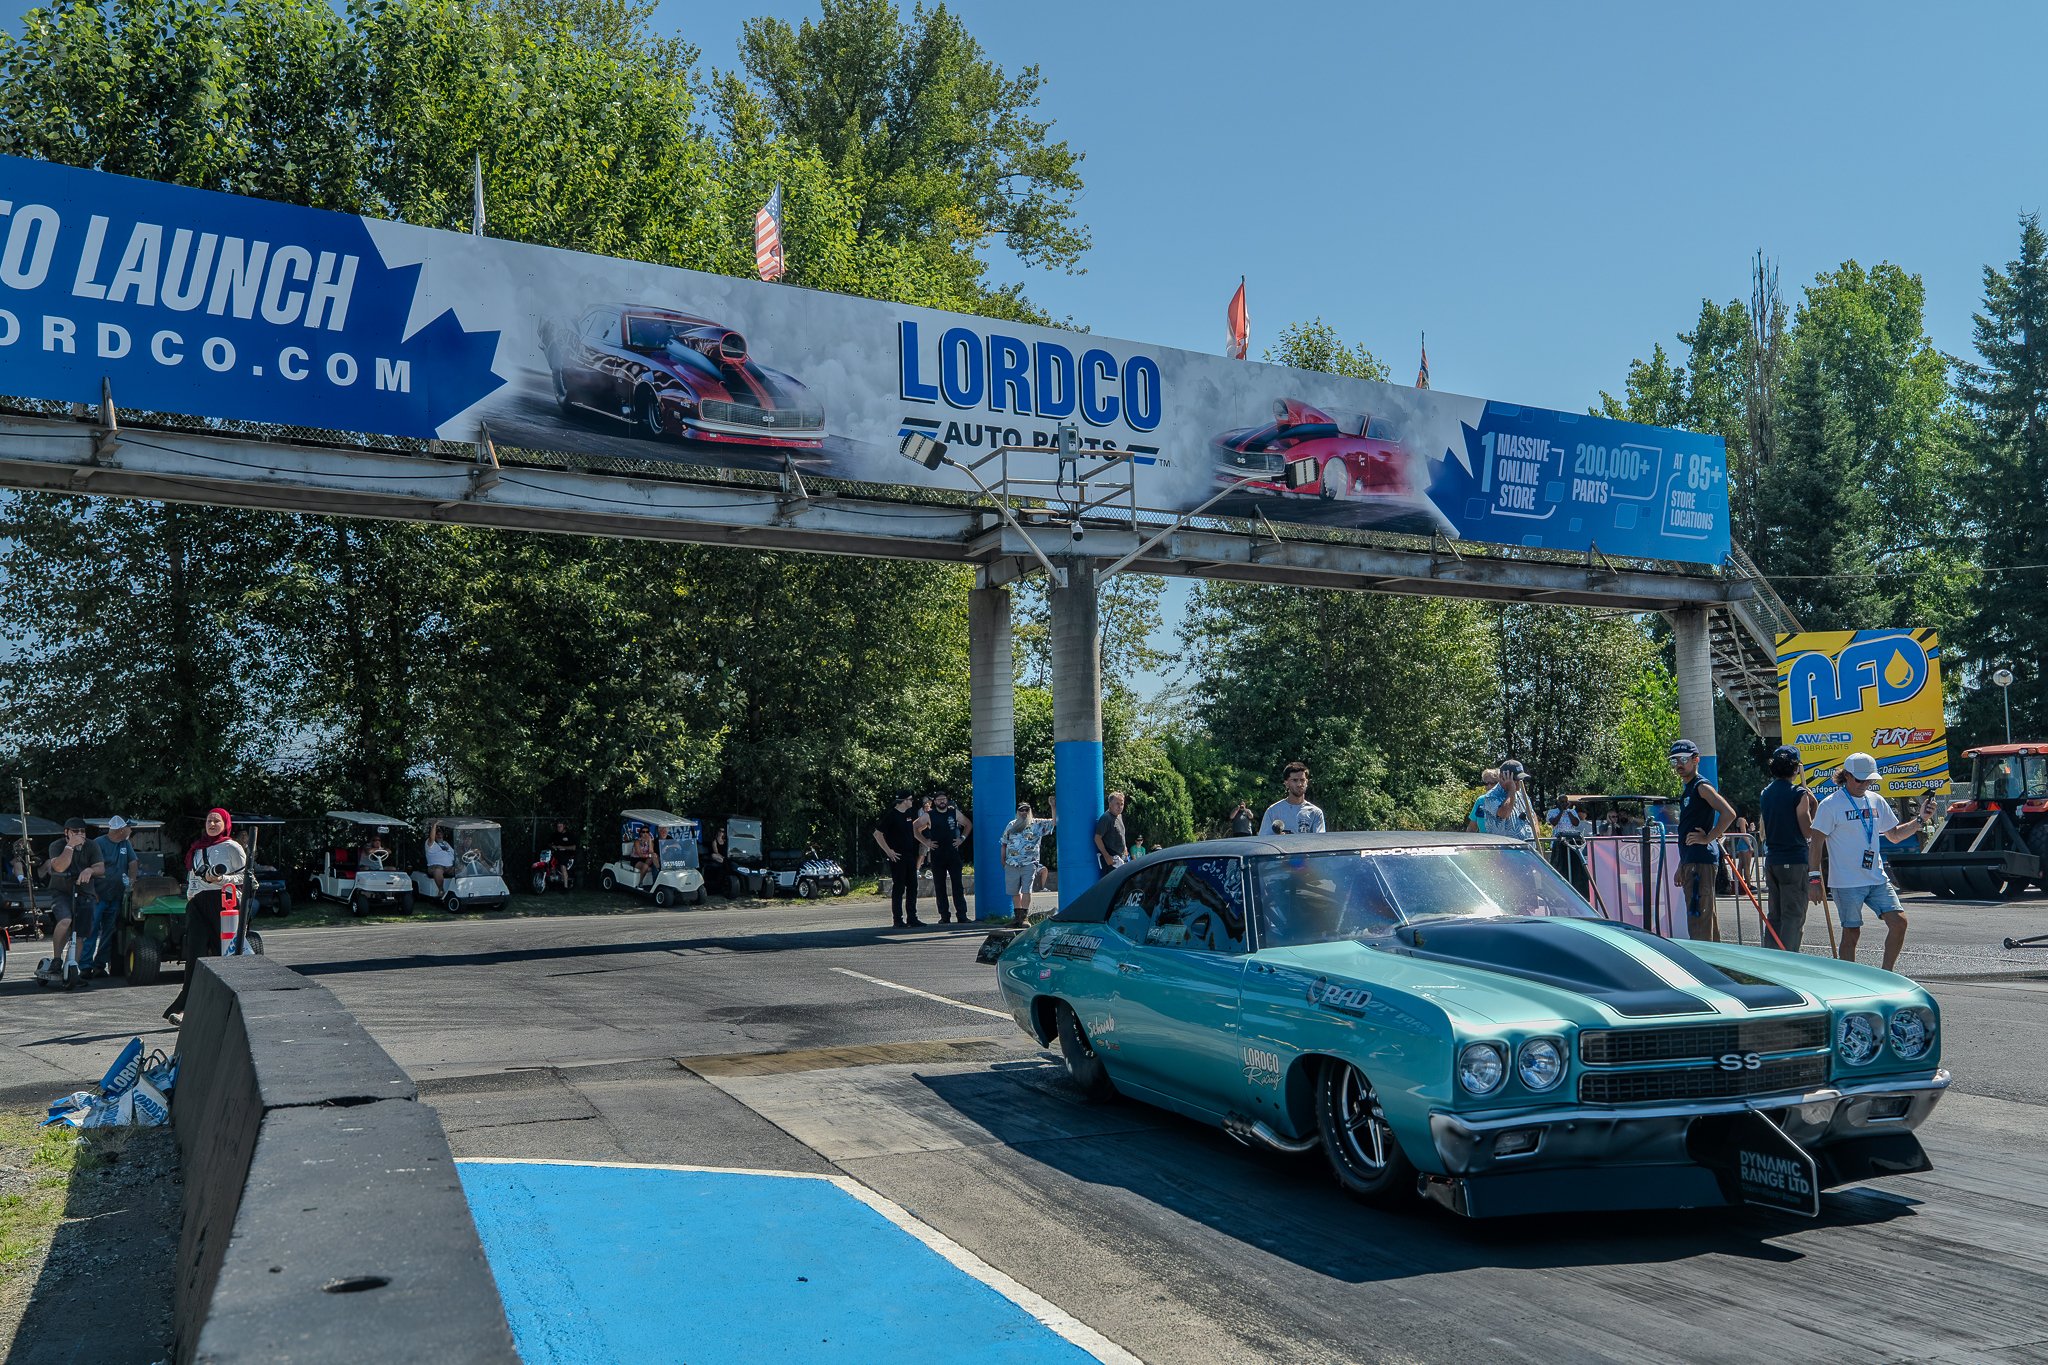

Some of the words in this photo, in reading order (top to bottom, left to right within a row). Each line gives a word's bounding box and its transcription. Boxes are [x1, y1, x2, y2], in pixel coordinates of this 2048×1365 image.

[0, 200, 60, 290] O
[72, 215, 360, 332] LAUNCH
[897, 320, 1162, 433] LORDCO
[944, 421, 1022, 447] AUTO
[1481, 431, 1495, 493] 1
[1497, 433, 1551, 462] MASSIVE
[1498, 458, 1540, 486] ONLINE
[1575, 443, 1650, 481] 200,000+
[1673, 452, 1683, 471] AT
[1688, 454, 1723, 491] 85+
[1499, 485, 1536, 510] STORE
[1572, 479, 1608, 504] PARTS
[1671, 490, 1696, 510] STORE
[1670, 511, 1714, 531] LOCATIONS
[1788, 636, 1928, 726] AFD
[1794, 731, 1853, 746] AWARD
[1799, 743, 1850, 752] LUBRICANTS
[1871, 727, 1917, 748] FURY
[1813, 768, 1836, 779] Qualit
[1882, 764, 1920, 775] Delivered.
[1889, 779, 1945, 791] 604-820-4887
[1125, 892, 1143, 907] ACE
[1320, 984, 1373, 1009] RAD
[1243, 1046, 1280, 1074] LORDCO
[1719, 1052, 1762, 1071] SS
[1242, 1066, 1283, 1091] Racing
[1739, 1150, 1802, 1177] DYNAMIC
[1740, 1166, 1785, 1189] RANGE
[1788, 1176, 1813, 1196] LTD.
